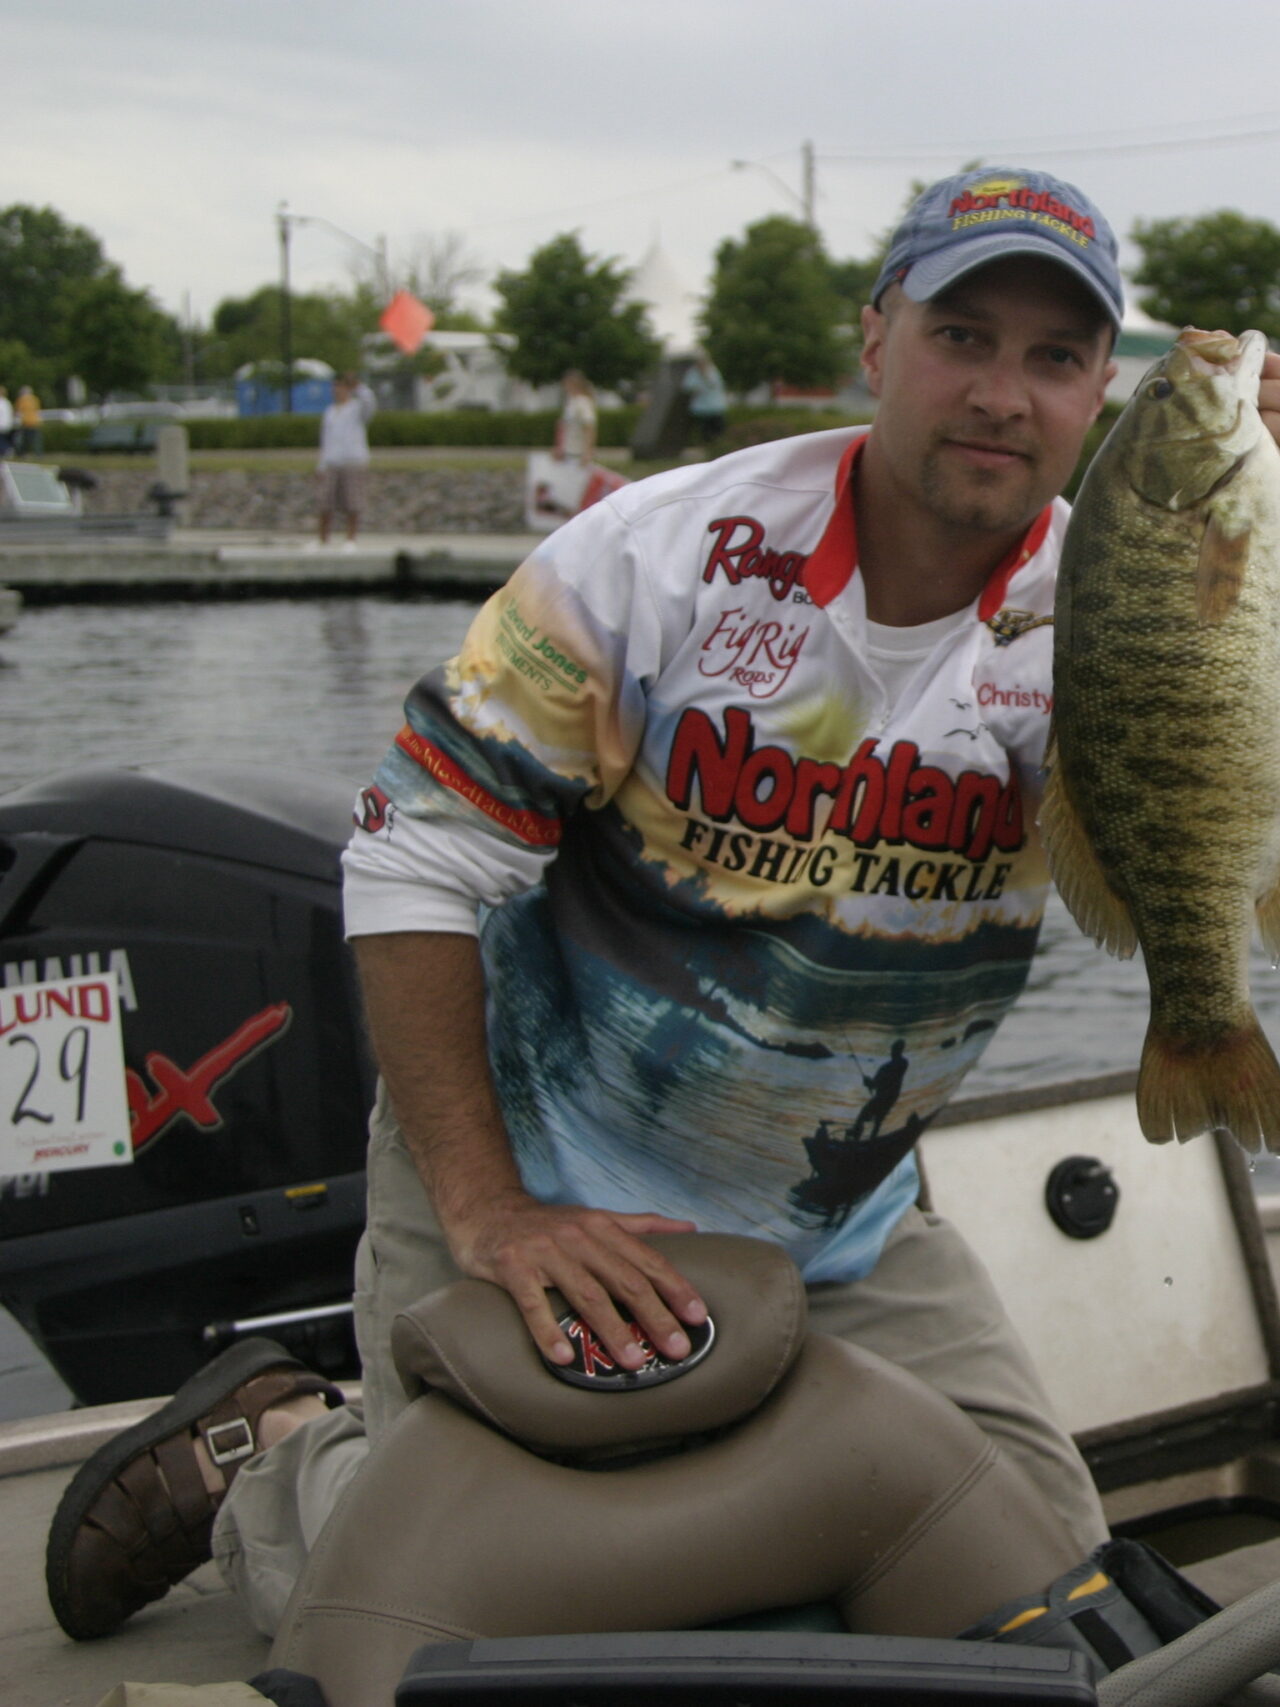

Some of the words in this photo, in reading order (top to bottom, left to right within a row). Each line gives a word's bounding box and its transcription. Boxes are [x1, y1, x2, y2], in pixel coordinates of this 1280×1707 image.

[948, 187, 1096, 241] Northland
[952, 209, 1025, 231] FISHING
[1030, 211, 1089, 249] TACKLE
[532, 636, 588, 684] Jones
[977, 682, 1054, 714] Christy
[666, 706, 1025, 863] Norhland
[678, 818, 840, 887] FISHIG
[852, 850, 1013, 903] TACKLE
[9, 1026, 92, 1126] 29
